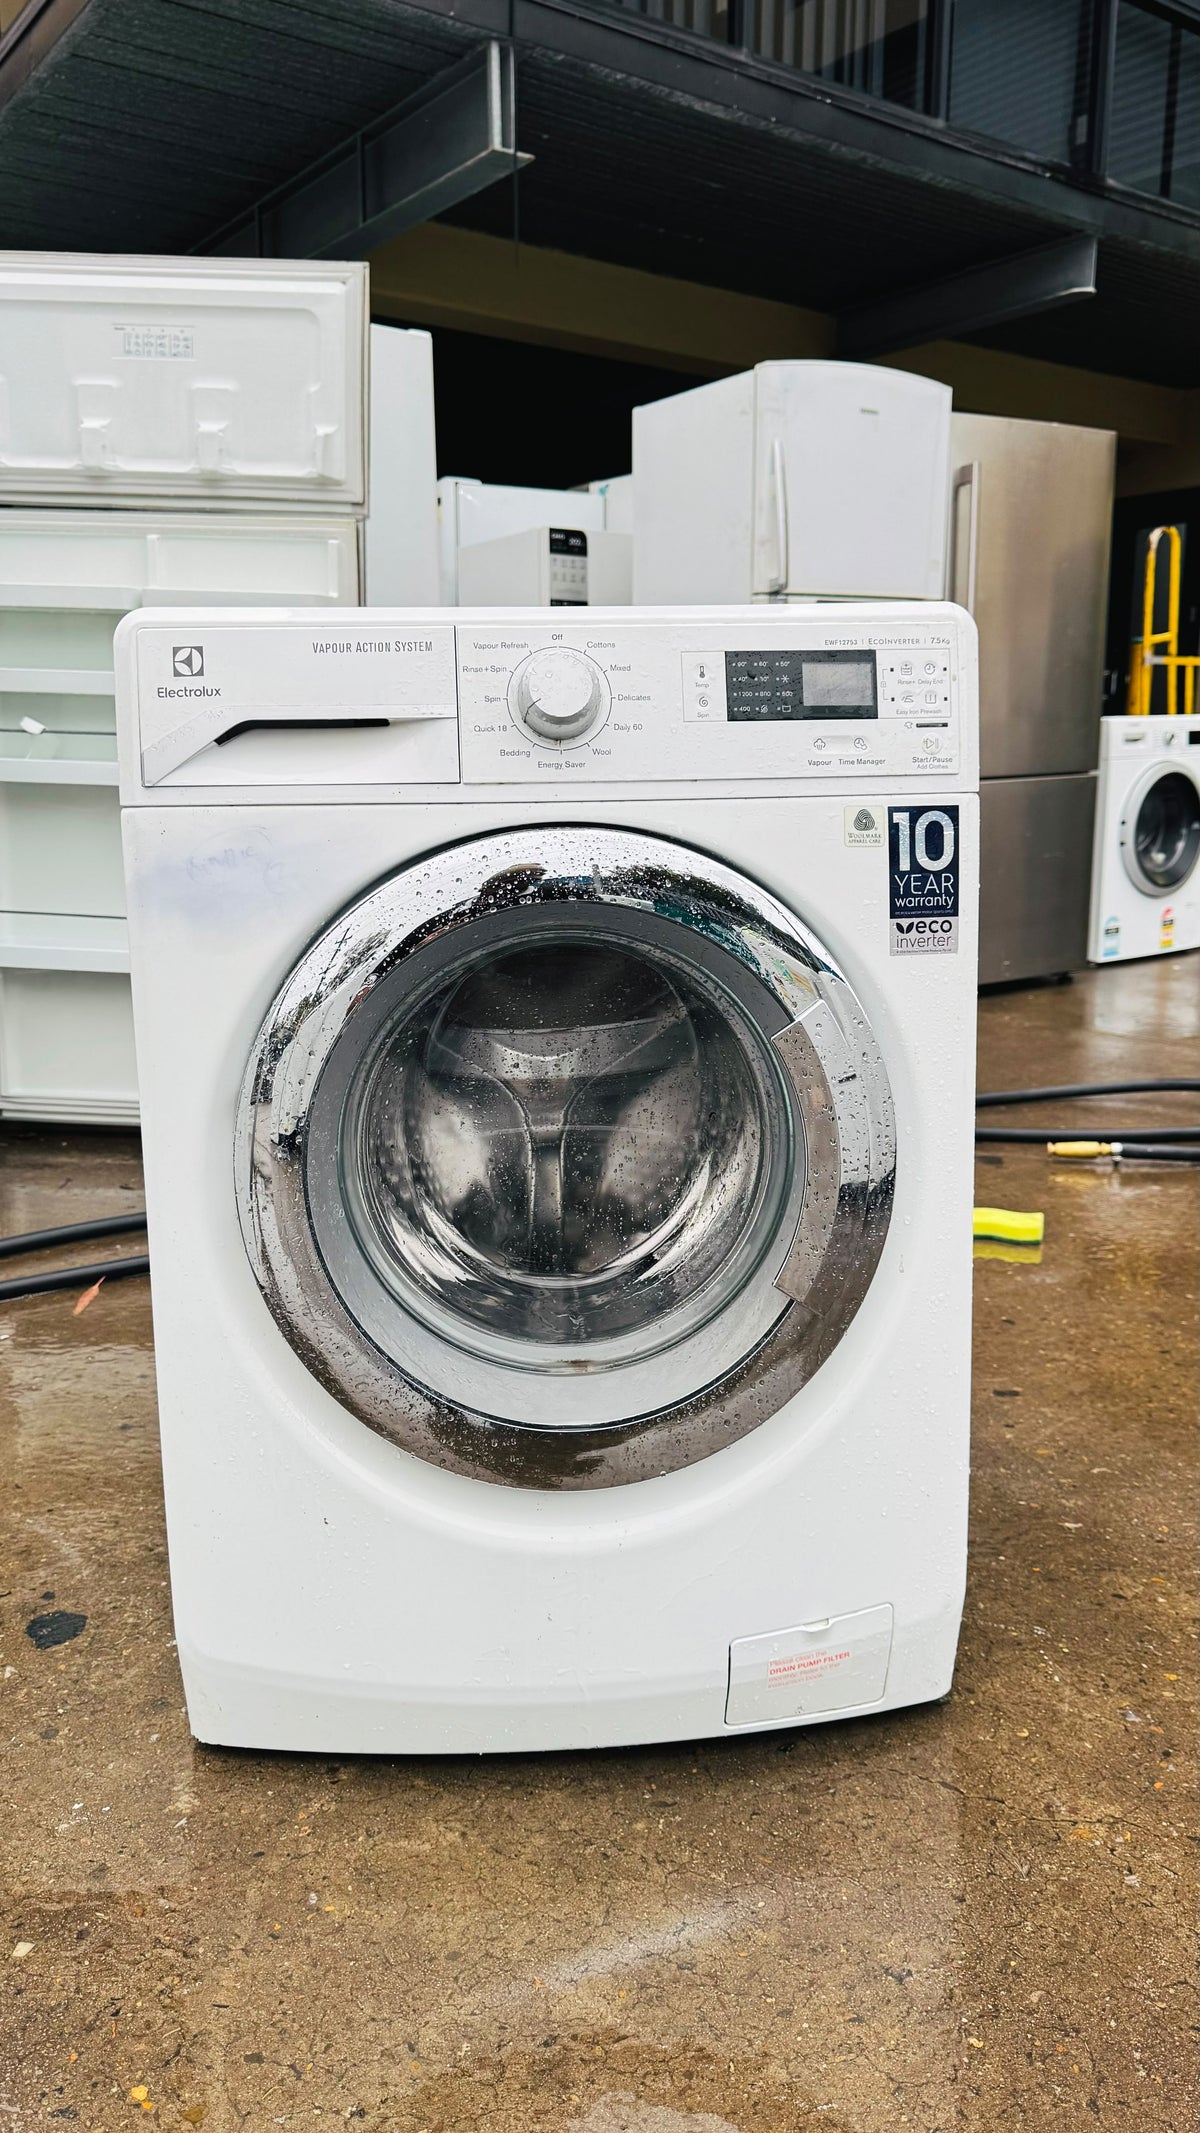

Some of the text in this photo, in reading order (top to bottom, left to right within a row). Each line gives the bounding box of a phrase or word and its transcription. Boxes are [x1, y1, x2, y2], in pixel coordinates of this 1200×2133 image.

[473, 641, 529, 650] Vapour Refresh
[586, 641, 616, 649] Cottons
[610, 664, 632, 672] Mixed
[157, 686, 222, 699] Electrolux
[484, 695, 501, 703] Spin
[613, 723, 643, 732] Daily 60
[500, 749, 531, 758] Bedding
[592, 748, 612, 756] Wool
[807, 759, 832, 767] Vapour
[856, 758, 886, 766] Manager
[912, 756, 953, 764] Start/Pause
[538, 761, 563, 770] Energy
[892, 810, 955, 872] 10
[894, 873, 954, 895] YEAR
[895, 893, 955, 909] warranty
[915, 919, 953, 934] eco
[896, 934, 952, 949] inverter
[769, 1652, 850, 1675] DRAIN PUMP FILTER
